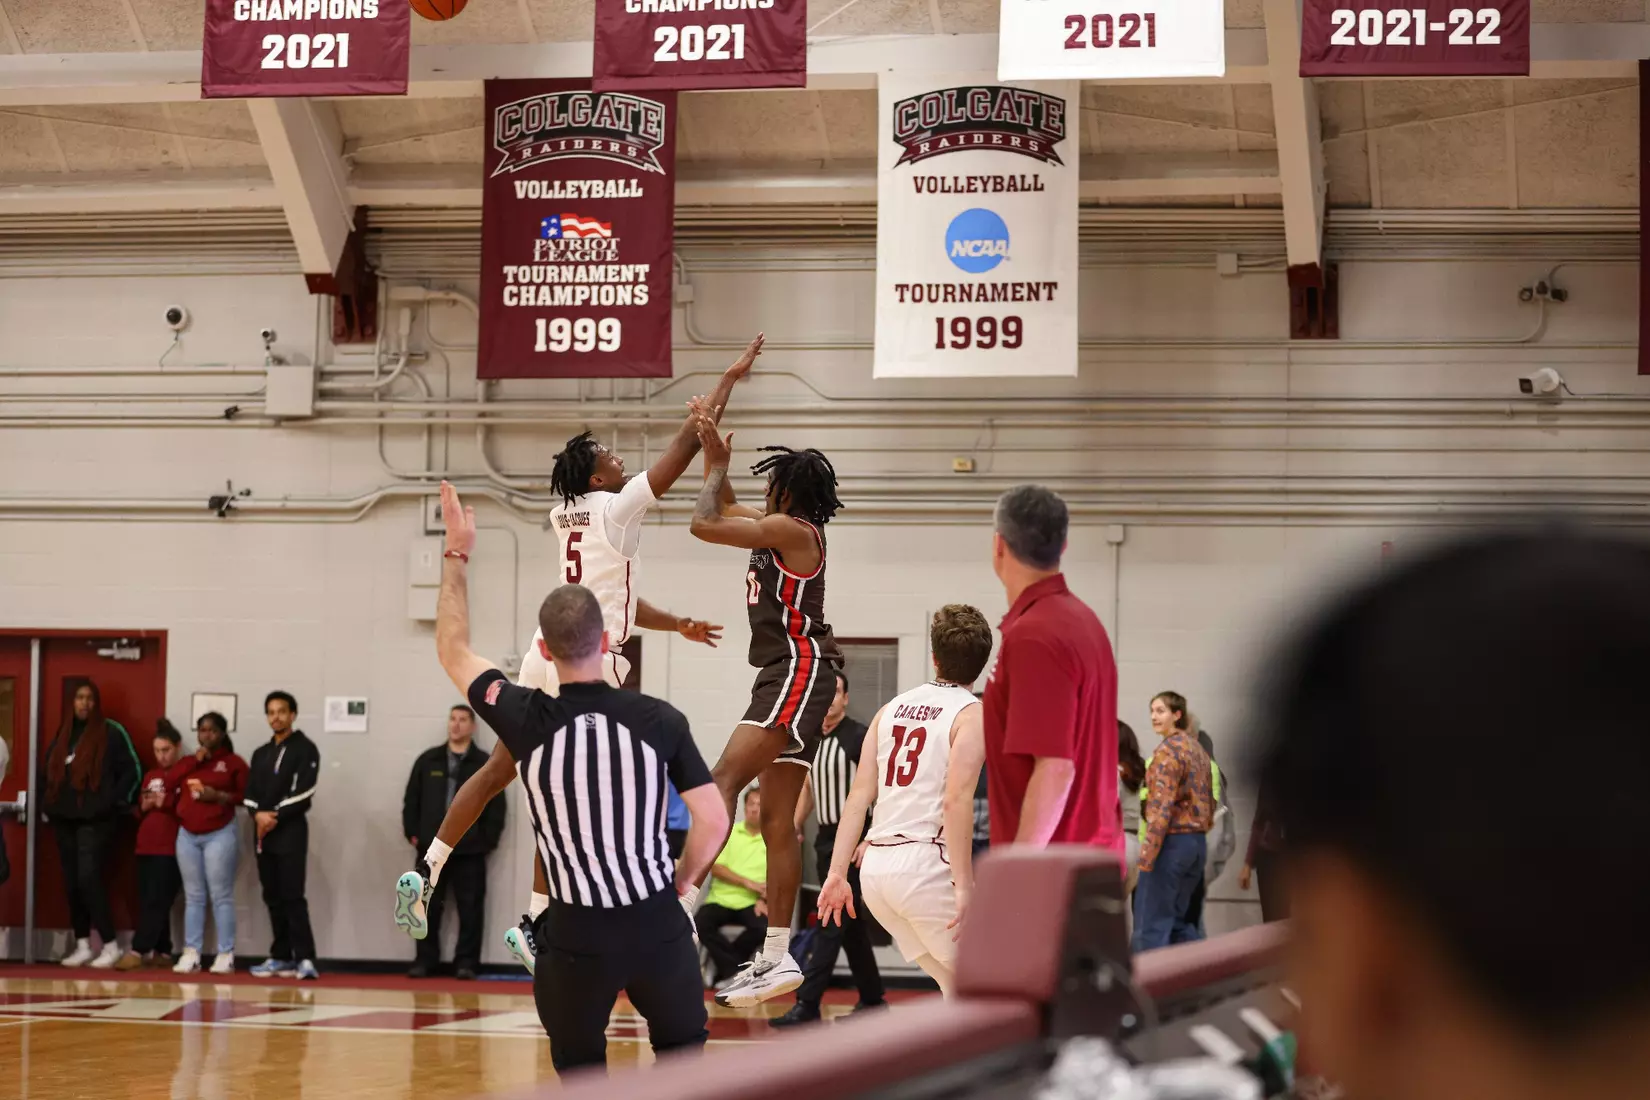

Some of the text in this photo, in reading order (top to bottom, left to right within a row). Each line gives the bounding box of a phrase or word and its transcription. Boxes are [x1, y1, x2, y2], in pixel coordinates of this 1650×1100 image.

[234, 0, 379, 21] CHAMPIONS
[1064, 13, 1156, 49] 2021
[1330, 8, 1501, 46] 2021-22
[261, 33, 349, 69] 2021
[654, 24, 745, 62] 2021
[500, 94, 662, 143] COLGATE
[895, 88, 1064, 138] COLGATE
[521, 139, 637, 160] RAIDERS
[918, 133, 1039, 154] RAIDERS
[514, 178, 643, 199] VOLLEYBALL
[913, 174, 1045, 194] VOLLEYBALL
[533, 237, 621, 251] PATRIOT
[950, 239, 1009, 257] NCAA
[533, 250, 620, 262] LEAGUE
[502, 264, 650, 284] TOURNAMENT
[502, 284, 650, 307] CHAMPIONS
[895, 281, 1058, 303] TOURNAMENT
[534, 317, 622, 353] 1999
[935, 315, 1023, 350] 1999
[566, 531, 584, 585] 5
[884, 724, 927, 787] 13
